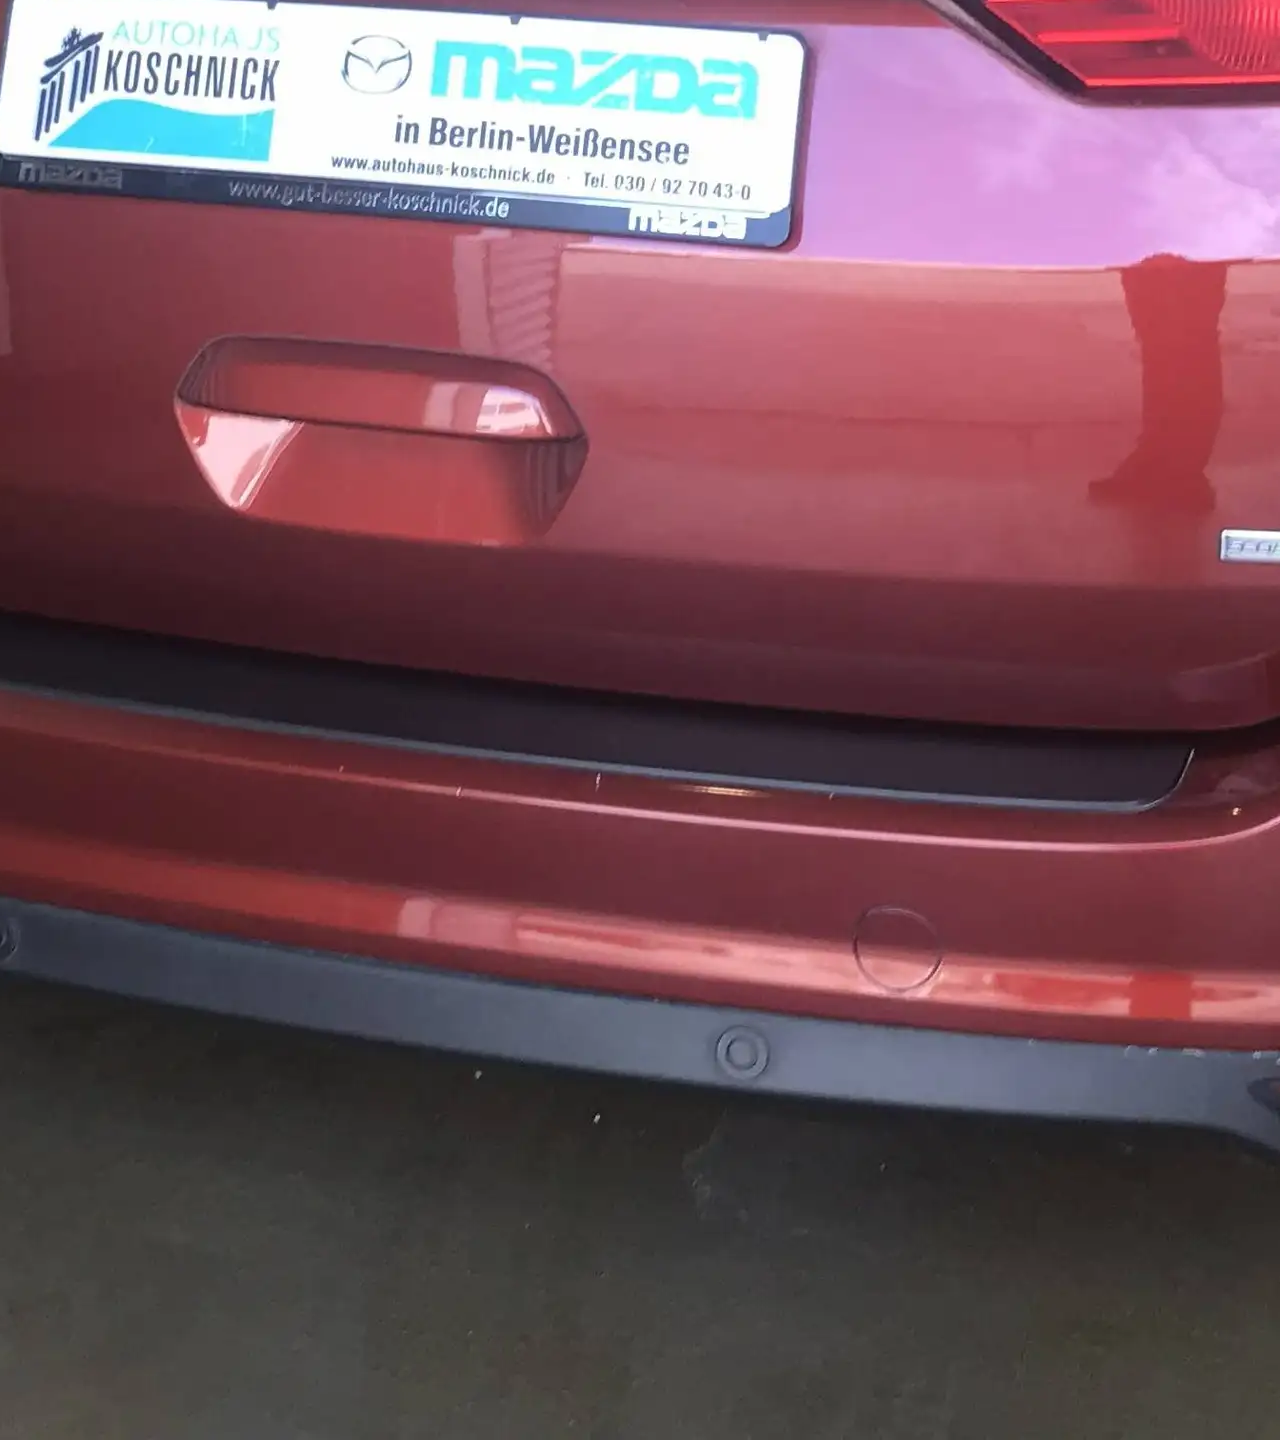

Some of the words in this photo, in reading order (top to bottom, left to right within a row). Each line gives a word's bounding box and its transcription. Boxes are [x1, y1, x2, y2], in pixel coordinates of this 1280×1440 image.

[104, 49, 281, 101] KOSCHNICK
[430, 39, 760, 120] mazda
[394, 115, 420, 144] in
[428, 117, 691, 166] Berlin-Weißensee
[17, 160, 123, 190] mazda
[331, 154, 556, 186] www.autohaus-koschnick.de
[584, 171, 609, 189] Tel.
[614, 174, 646, 193] 030
[662, 177, 683, 195] 92
[688, 180, 708, 197] 70
[227, 179, 511, 219] www.gut-besser-koschnick.de
[627, 208, 748, 241] mazda
